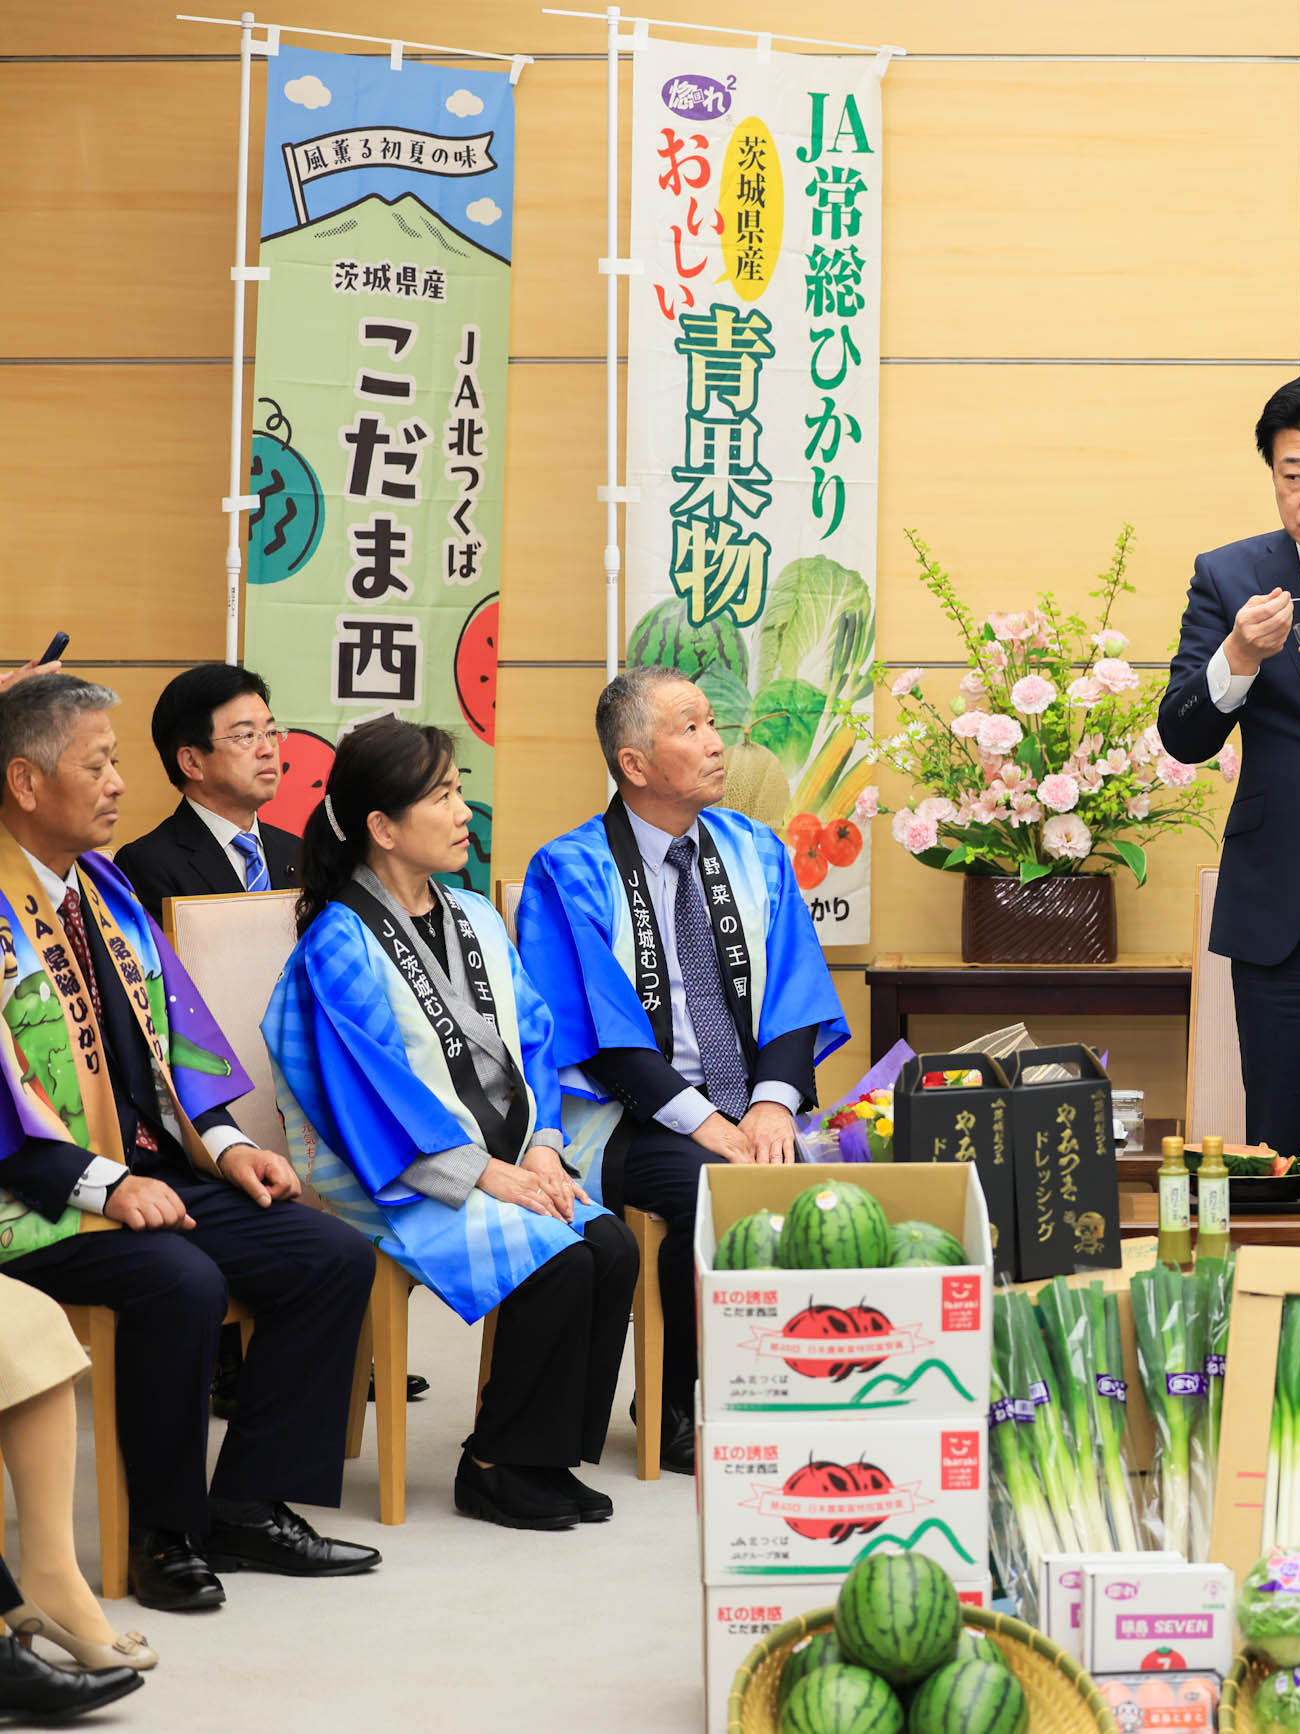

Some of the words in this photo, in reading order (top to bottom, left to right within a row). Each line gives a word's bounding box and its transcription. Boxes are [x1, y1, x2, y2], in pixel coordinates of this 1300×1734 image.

[305, 137, 478, 174] 風薫る初夏の味
[653, 127, 725, 320] おいしい
[736, 136, 767, 281] 茨城県産
[334, 262, 446, 300] 茨城県産
[796, 92, 875, 540] JA常総ひかり
[449, 331, 485, 578] JA北つくば
[670, 303, 776, 627] 青果物
[338, 323, 428, 737] こだま西
[627, 869, 662, 1012] JA茨城むつみ
[703, 856, 748, 998] 野菜の王国
[807, 897, 850, 922] かり
[25, 894, 101, 1074] JA常総ひかり
[382, 919, 464, 1058] JA茨城むつみ
[1035, 1131, 1055, 1242] ドレッシング
[1154, 1619, 1209, 1633] SEVEN
